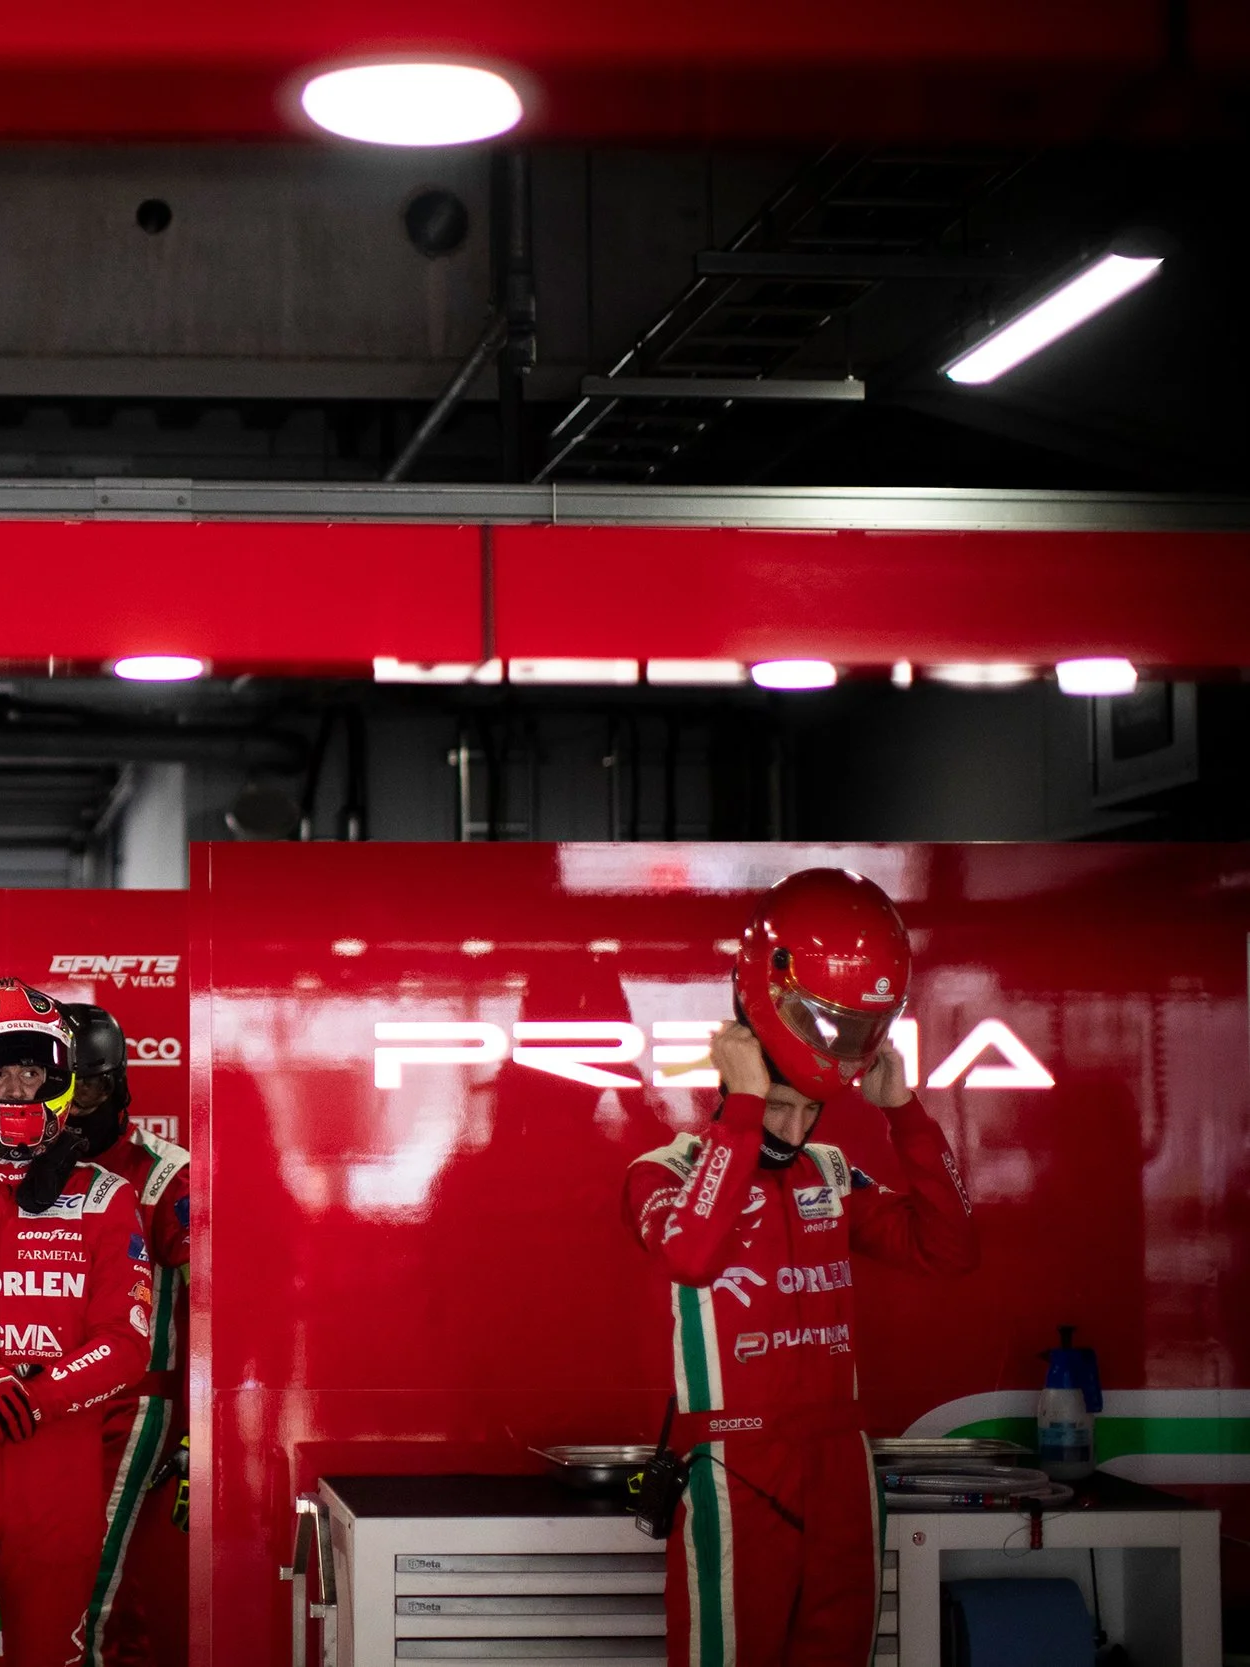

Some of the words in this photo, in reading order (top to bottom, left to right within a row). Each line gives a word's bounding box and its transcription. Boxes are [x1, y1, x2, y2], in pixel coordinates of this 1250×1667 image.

[49, 955, 181, 974] GPNFTS
[130, 976, 176, 988] VELAS
[6, 1022, 35, 1030] ORLEN
[374, 1020, 1057, 1090] PREA
[8, 1173, 27, 1181] ORL
[149, 1162, 176, 1198] sparco
[694, 1145, 732, 1219] sparco
[17, 1250, 87, 1263] FARMETAL
[777, 1260, 853, 1294] ORLEN
[66, 1344, 111, 1373] ORLEN
[84, 1383, 127, 1409] ORLEN
[709, 1417, 763, 1432] sparco
